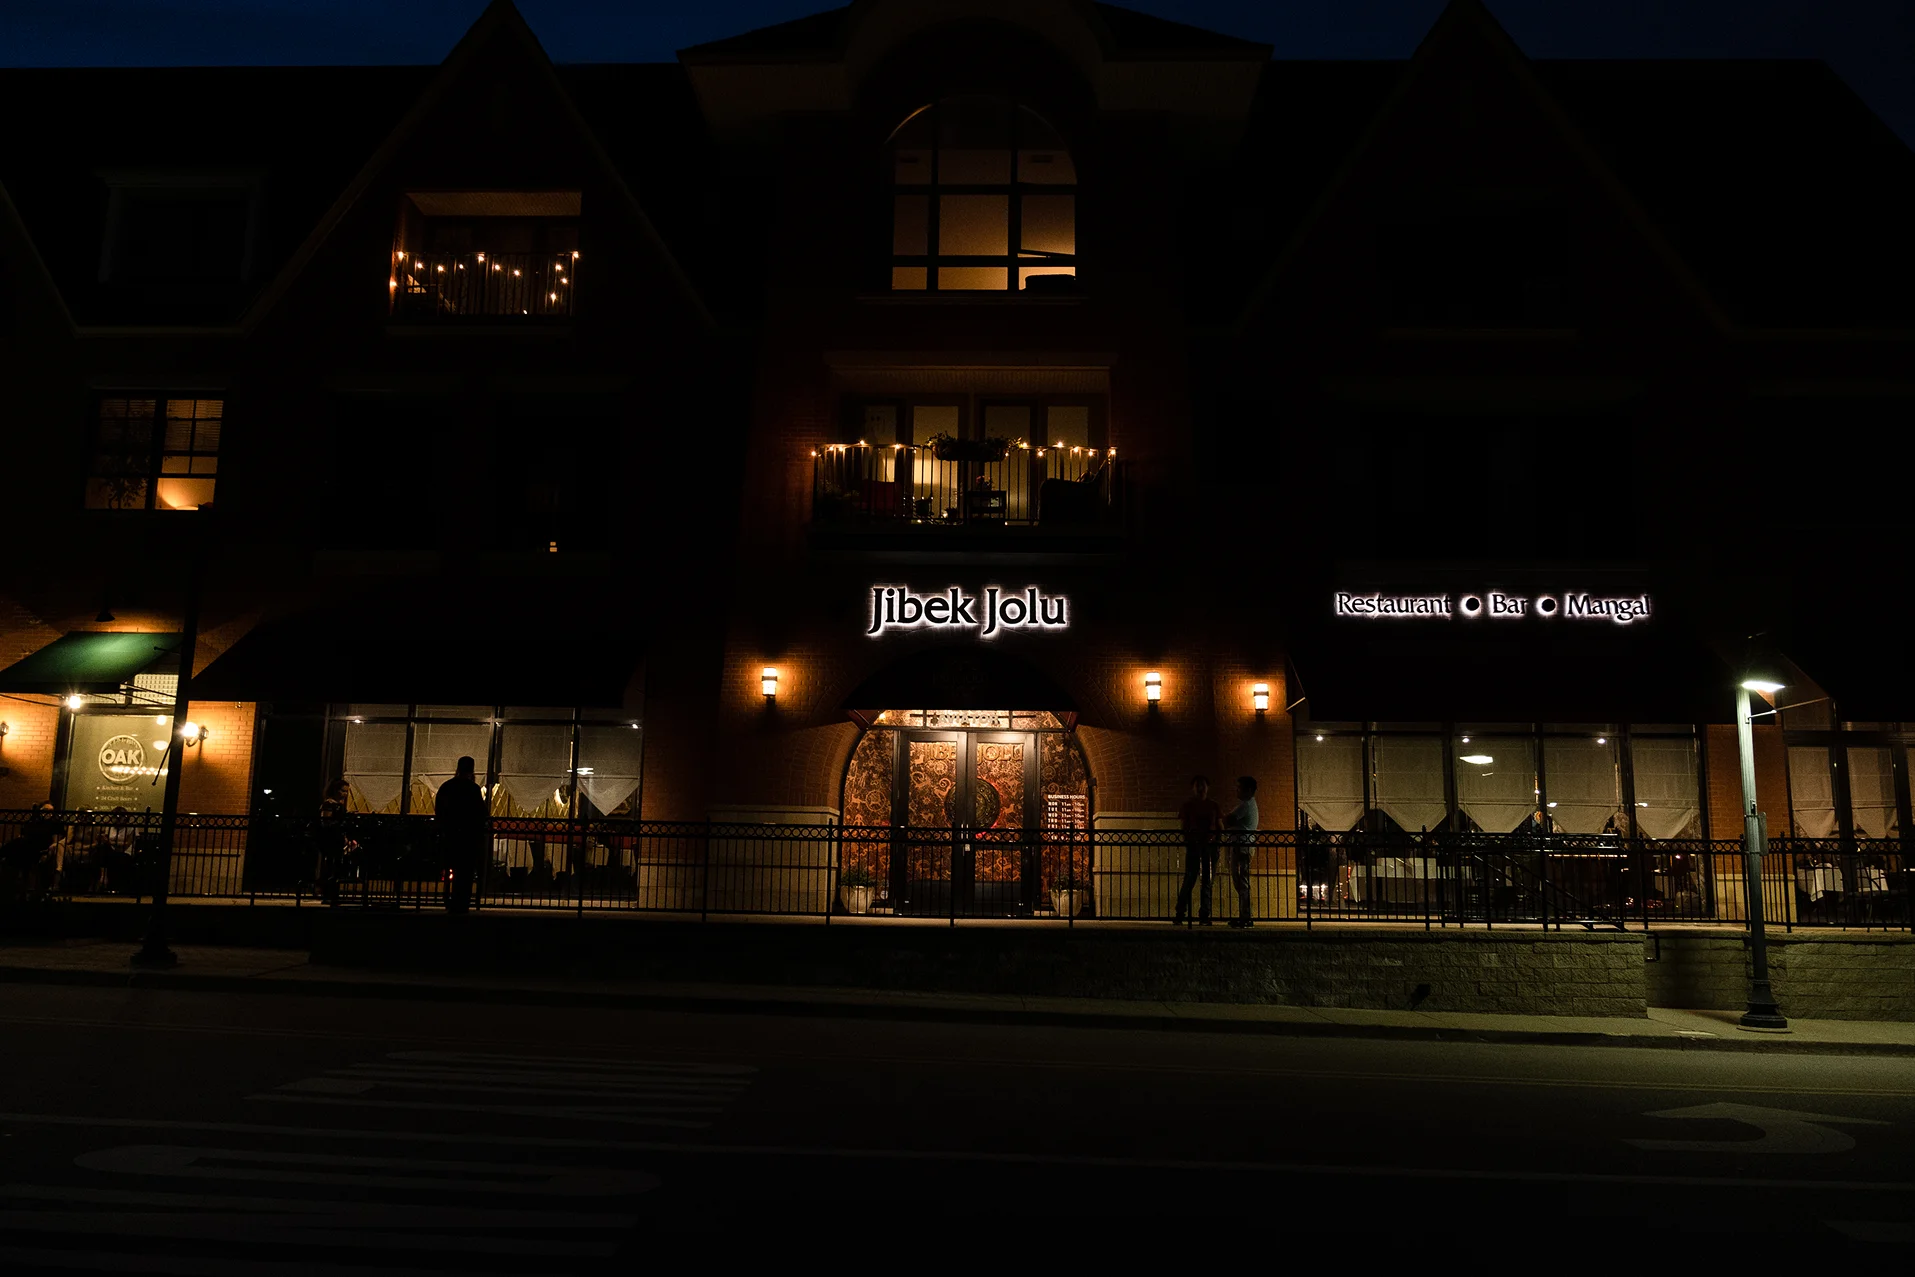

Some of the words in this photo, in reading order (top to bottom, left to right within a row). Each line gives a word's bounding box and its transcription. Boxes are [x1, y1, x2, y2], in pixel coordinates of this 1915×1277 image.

[868, 587, 977, 635] Jibek
[982, 587, 1066, 635] Jolu
[1337, 593, 1453, 614] Restaurant
[1491, 594, 1530, 615] Bar
[1567, 594, 1651, 622] Mangal
[102, 749, 140, 765] OAK
